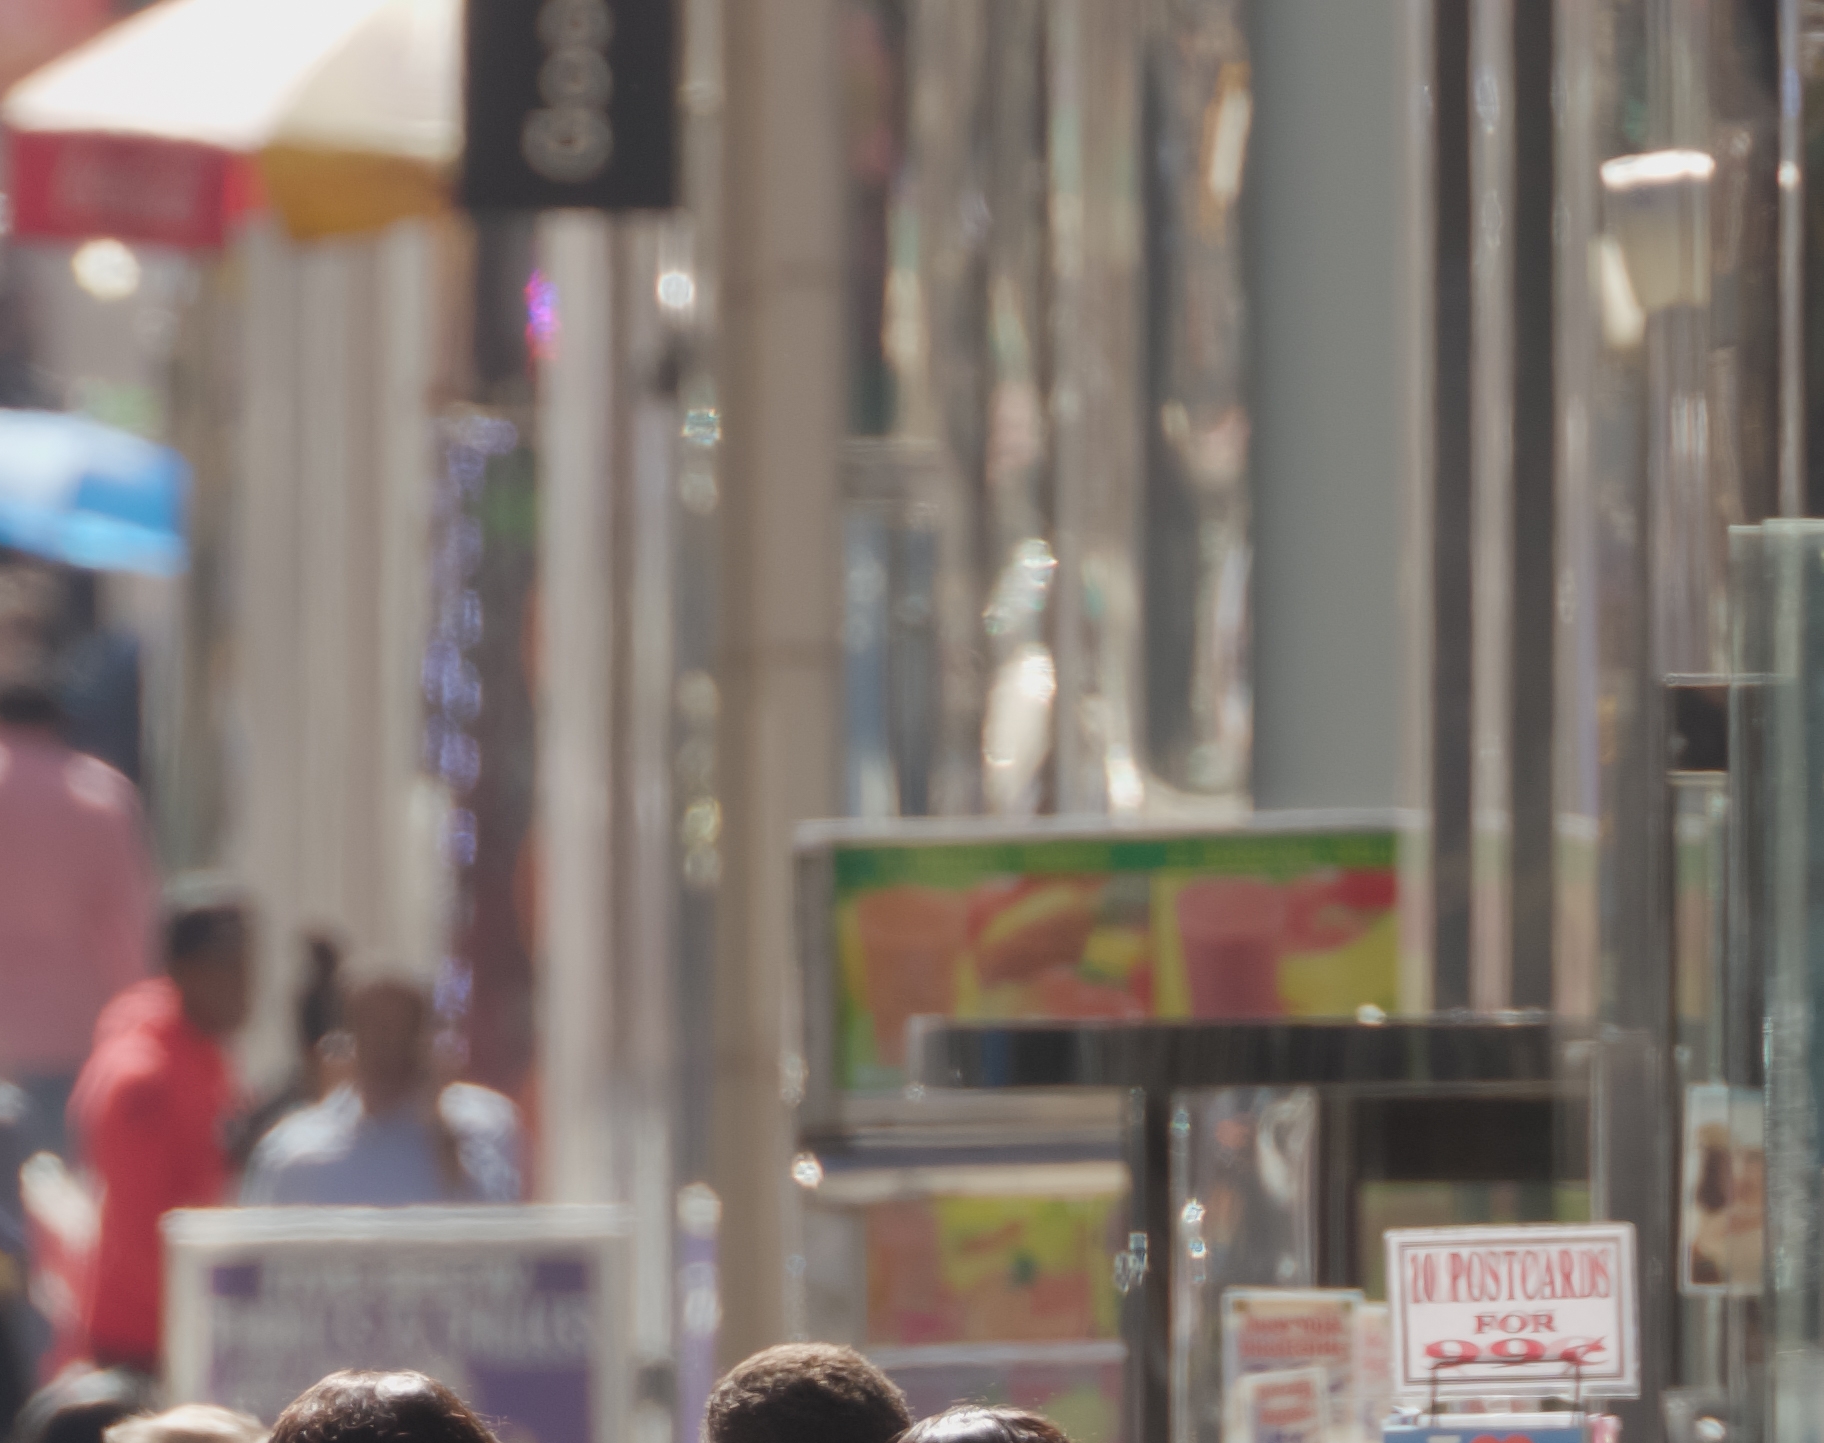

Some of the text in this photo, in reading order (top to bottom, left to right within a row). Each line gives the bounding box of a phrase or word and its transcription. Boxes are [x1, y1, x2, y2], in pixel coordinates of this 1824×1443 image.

[1410, 1249, 1611, 1304] 10 POSTCARDS
[1473, 1313, 1558, 1335] FOR
